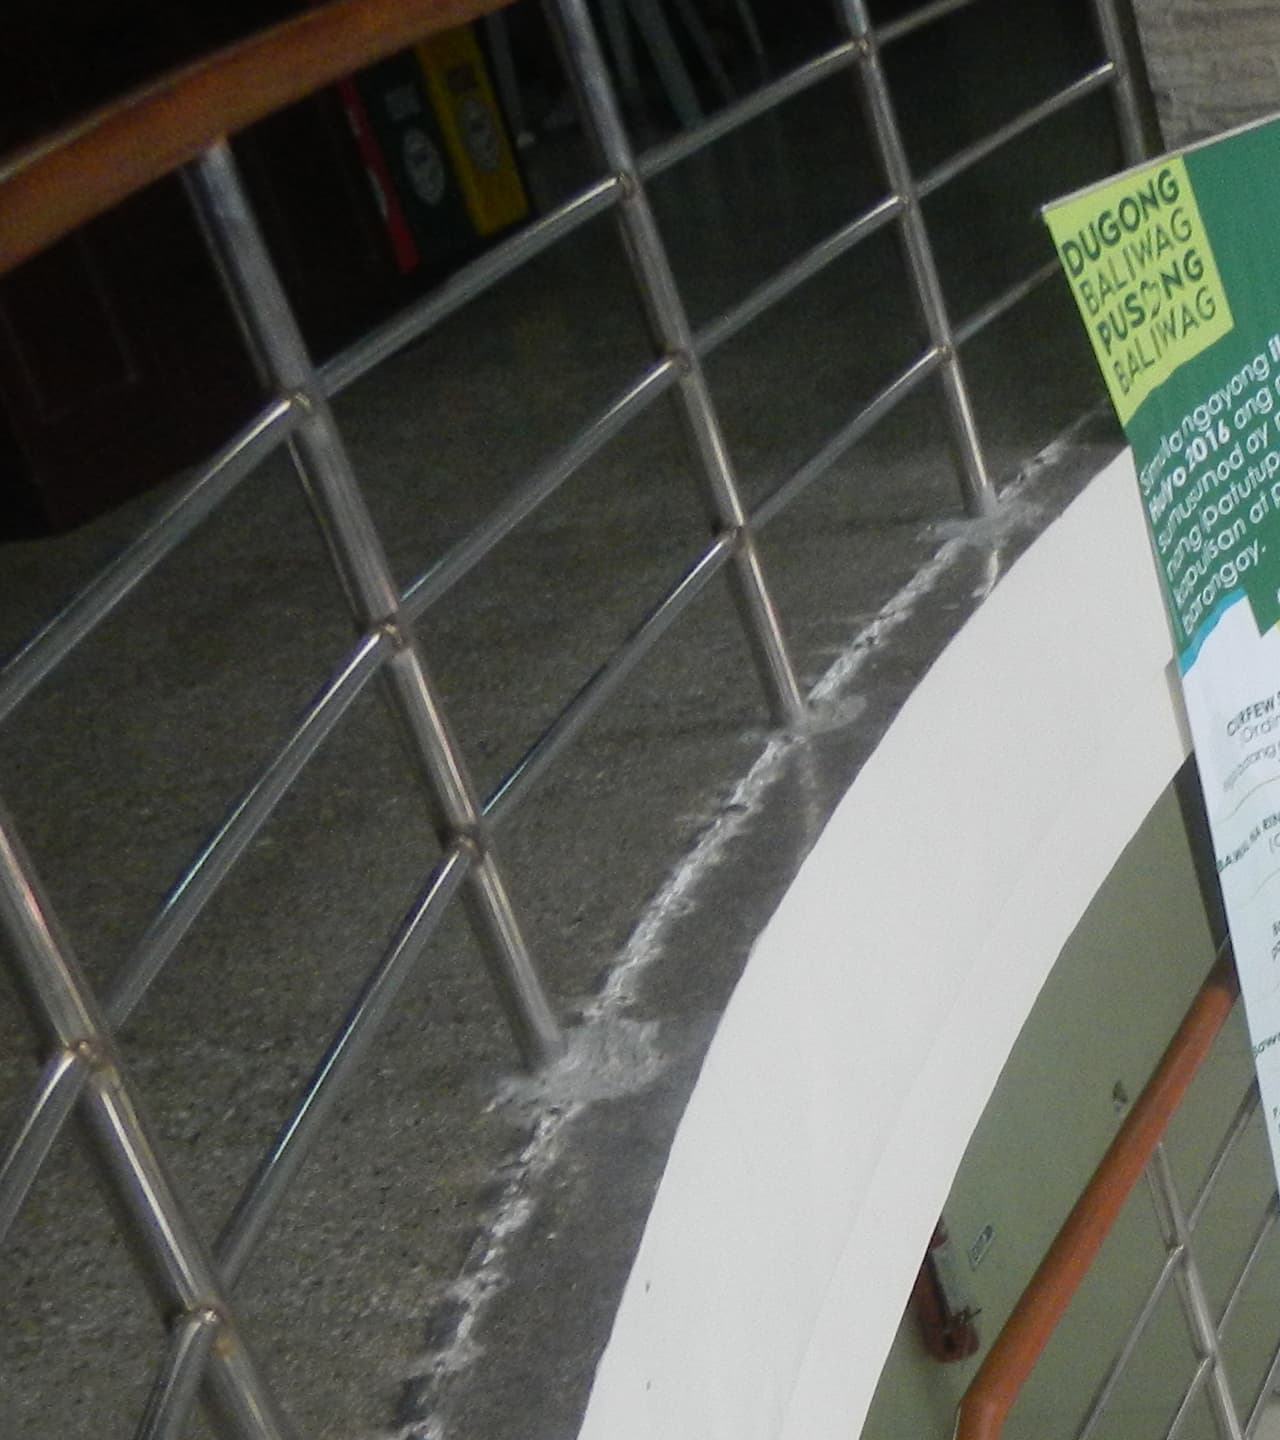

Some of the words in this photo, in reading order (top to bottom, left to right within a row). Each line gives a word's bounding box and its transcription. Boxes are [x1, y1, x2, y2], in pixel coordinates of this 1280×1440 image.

[1061, 168, 1180, 280] DUGONG
[1078, 207, 1192, 316] BALIWAG
[1113, 286, 1216, 395] BALIWAG
[1184, 419, 1230, 473] 2016
[1234, 386, 1274, 430] ang
[1246, 421, 1270, 454] ay
[1248, 492, 1269, 524] at
